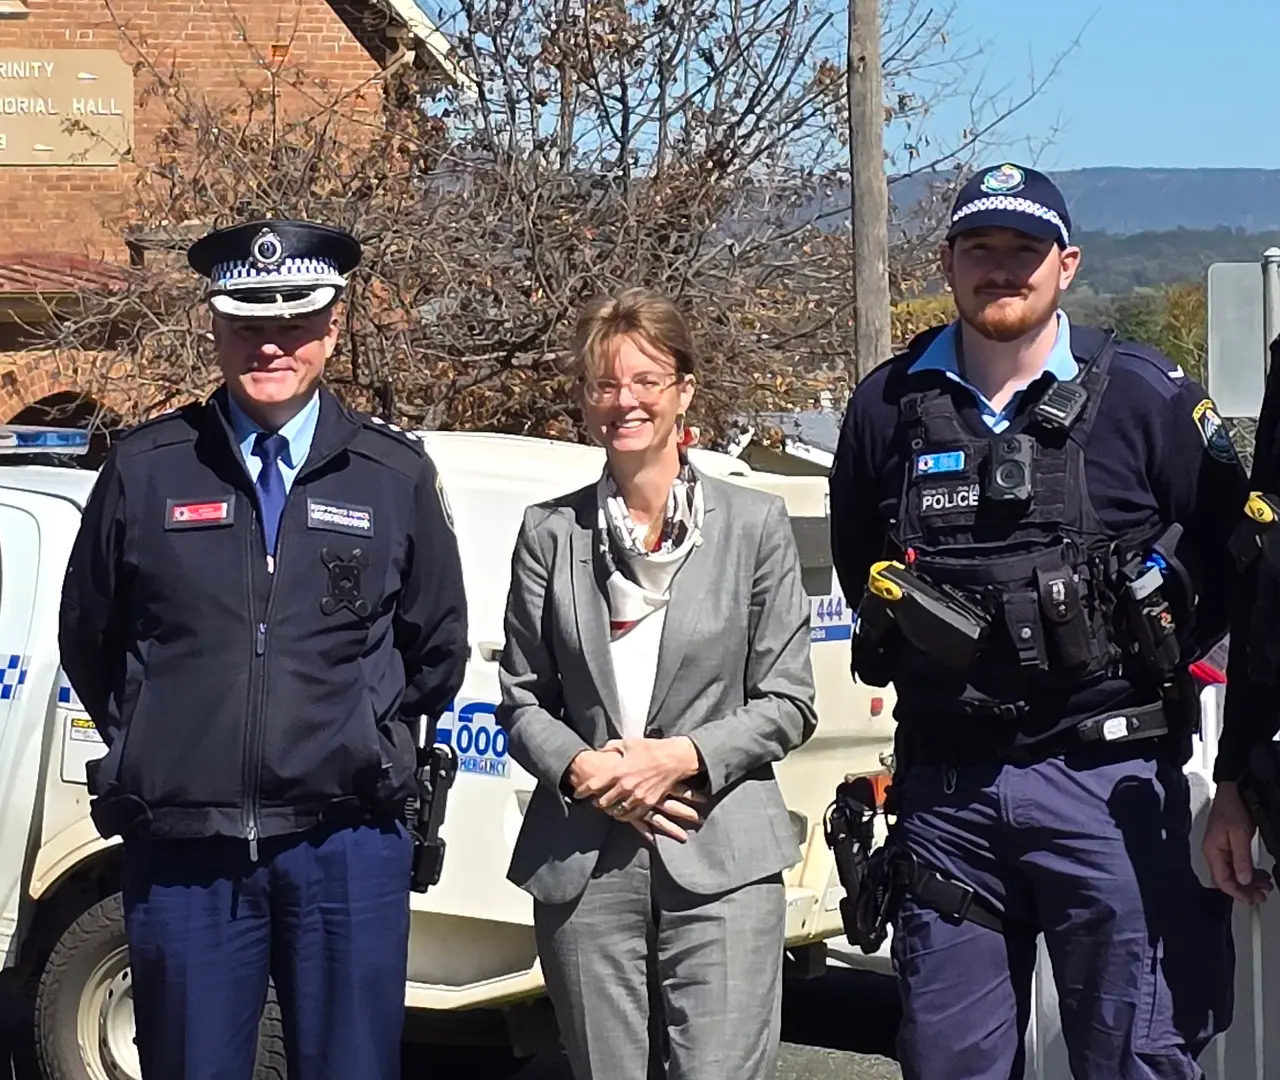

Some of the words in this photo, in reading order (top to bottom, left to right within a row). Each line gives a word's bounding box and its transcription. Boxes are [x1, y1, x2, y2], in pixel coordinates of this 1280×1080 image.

[72, 97, 123, 116] HALL
[922, 491, 979, 510] POLICE
[817, 597, 843, 623] 444
[456, 724, 508, 758] 000
